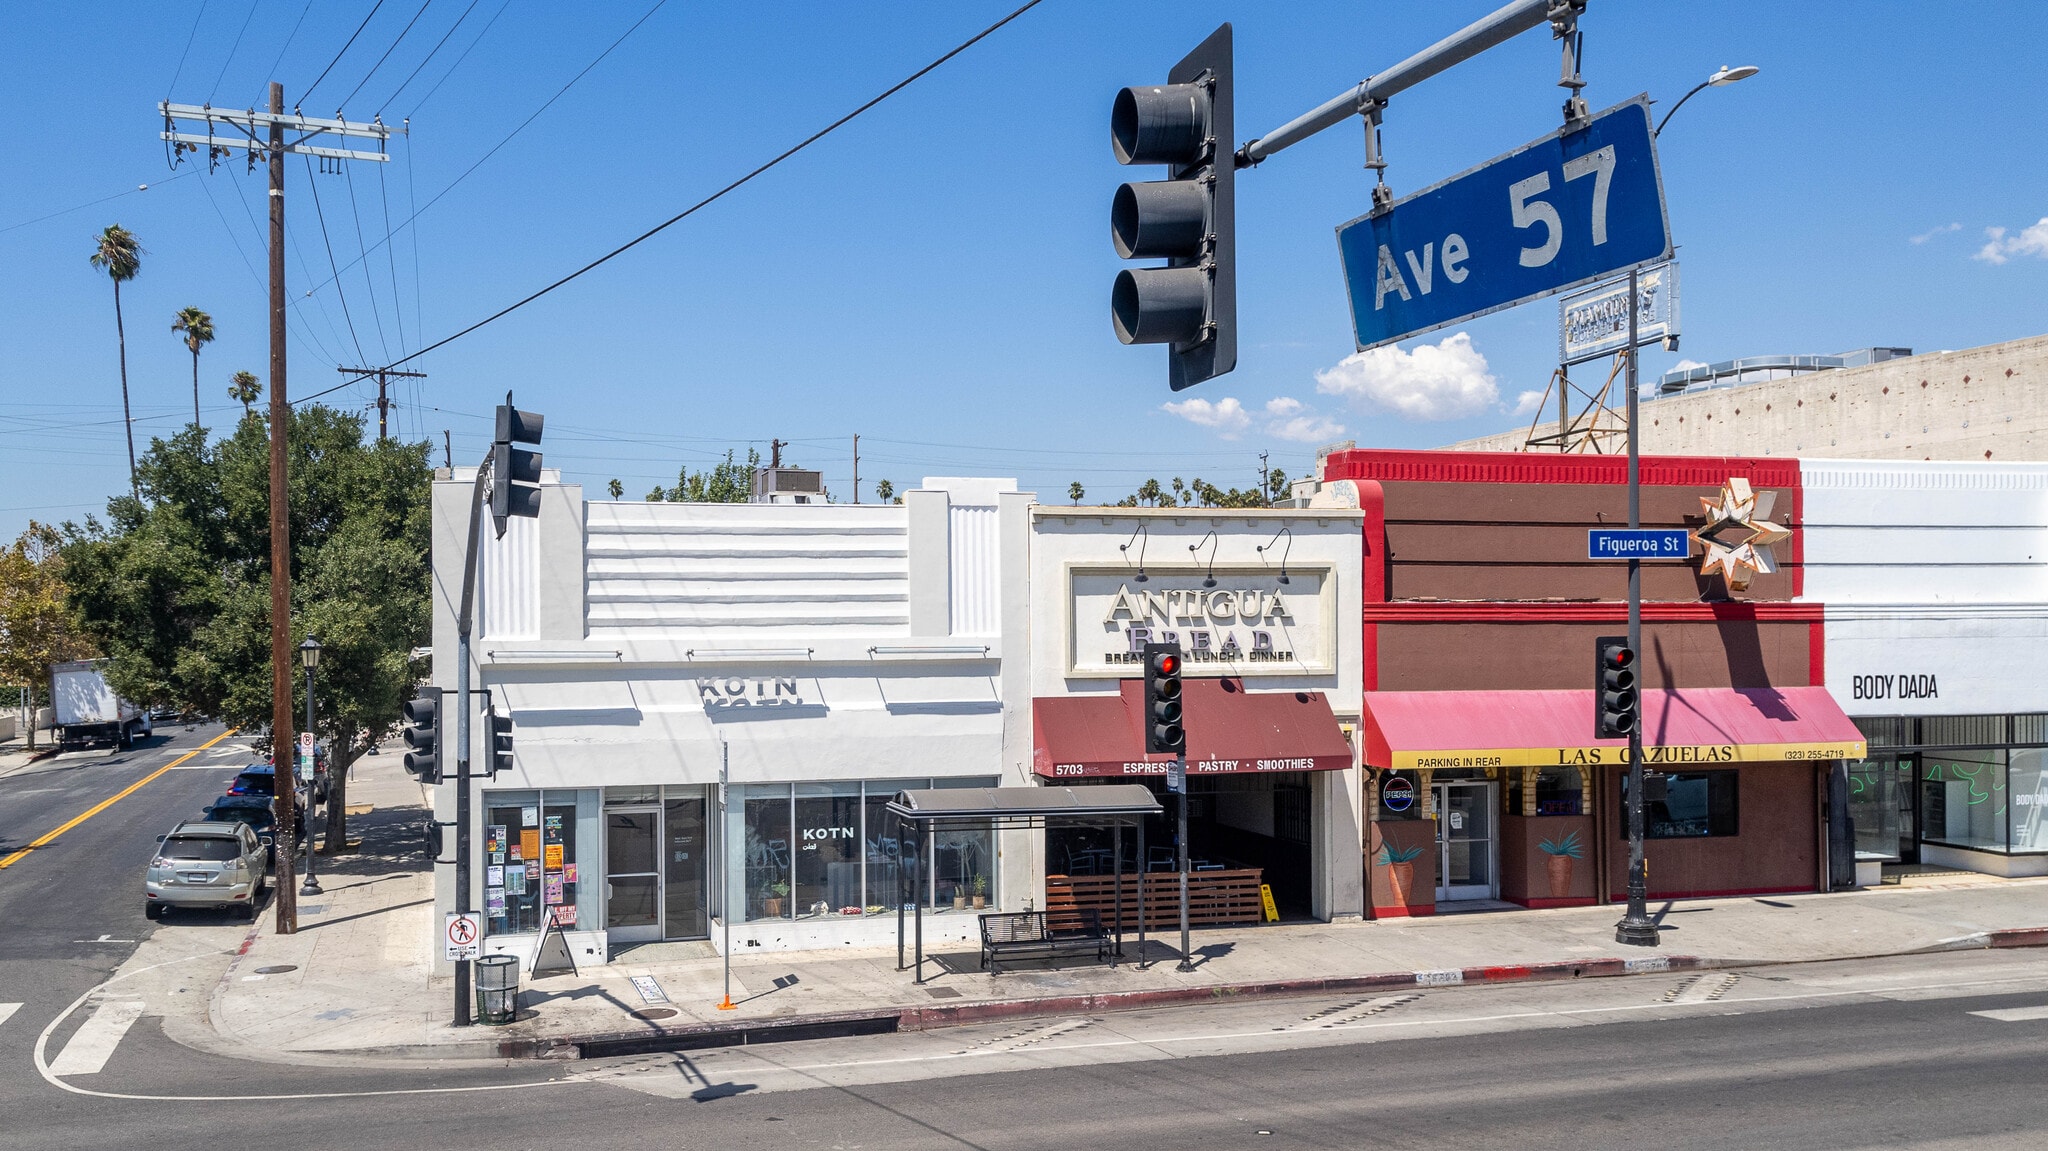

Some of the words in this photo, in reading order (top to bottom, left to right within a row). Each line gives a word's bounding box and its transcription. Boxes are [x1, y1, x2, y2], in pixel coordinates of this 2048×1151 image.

[1375, 233, 1470, 311] Ave
[1509, 144, 1616, 268] 57
[1599, 536, 1658, 556] Figueroa
[1663, 536, 1679, 551] St
[1103, 583, 1295, 623] ANTIGUA
[1125, 627, 1273, 653] BREAD
[1105, 652, 1145, 663] BREAK
[1194, 652, 1236, 661] LUNCH
[1249, 651, 1294, 660] DINNER
[699, 675, 797, 697] KOTN
[1853, 674, 1894, 700] BODY
[1899, 674, 1938, 699] DADA
[1417, 757, 1460, 768] PARKING
[1463, 757, 1473, 767] IN
[1475, 756, 1502, 767] REAR
[1558, 748, 1601, 765] LAS
[1784, 750, 1805, 760] (323)
[1807, 749, 1844, 759] 255-4719
[1056, 764, 1083, 775] 5703
[1123, 762, 1168, 774] ESPRES
[1198, 760, 1239, 772] PASTRY
[1256, 758, 1314, 770] SMOOTHIES
[1386, 790, 1412, 799] PEPSI
[803, 826, 854, 840] KOTN
